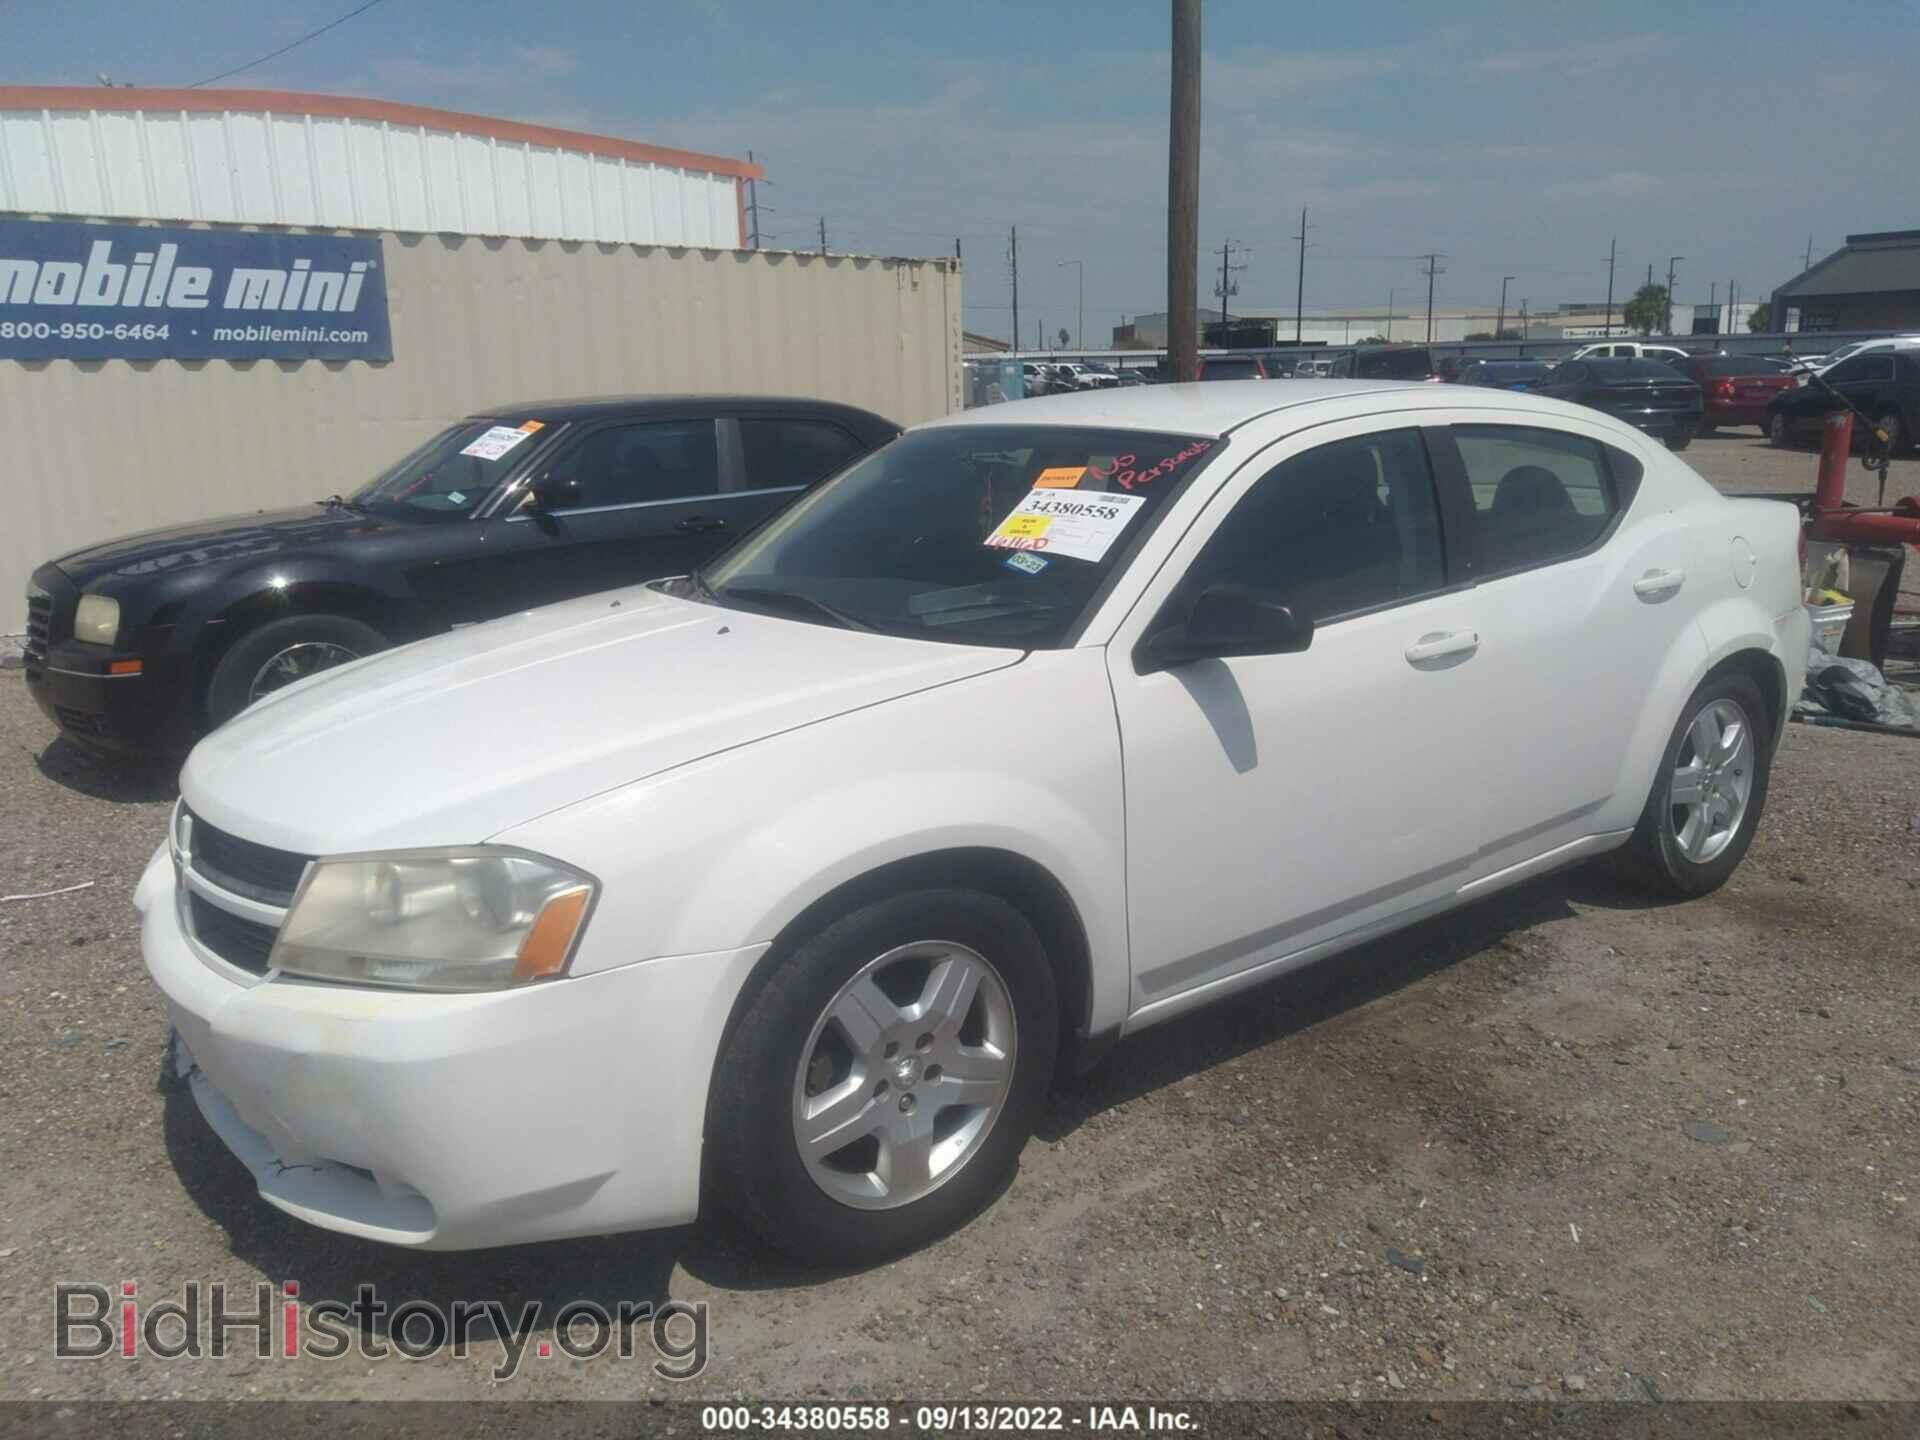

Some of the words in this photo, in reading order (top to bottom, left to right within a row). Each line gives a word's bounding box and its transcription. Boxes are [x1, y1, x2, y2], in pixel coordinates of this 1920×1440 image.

[223, 259, 367, 312] mini
[213, 327, 368, 343] mobilemini.com
[1024, 499, 1119, 521] 34380558
